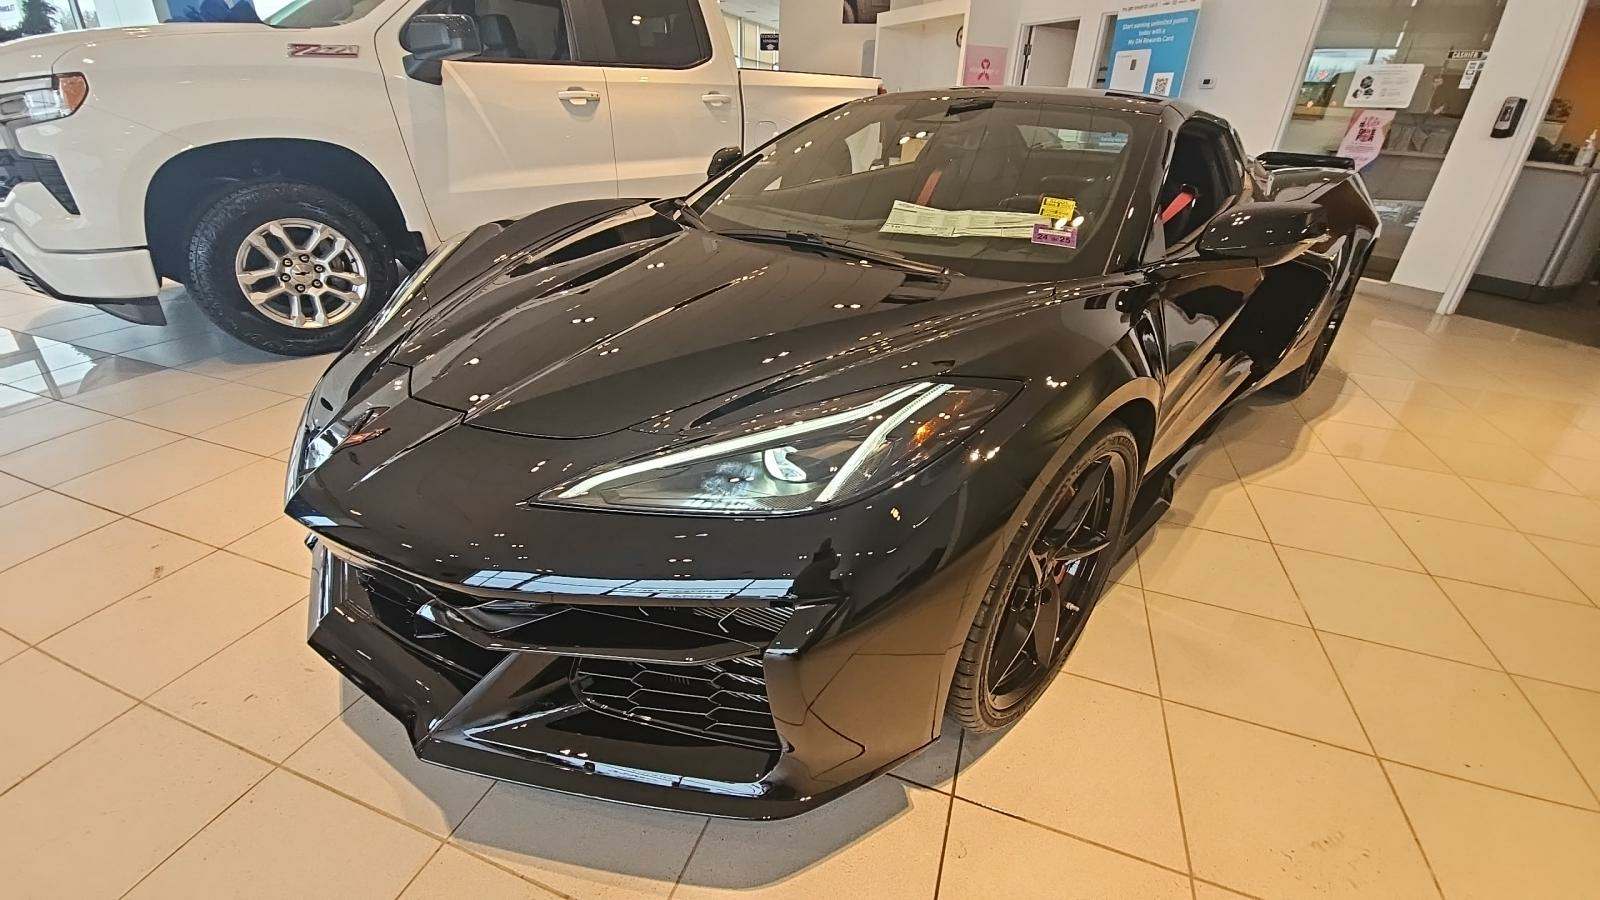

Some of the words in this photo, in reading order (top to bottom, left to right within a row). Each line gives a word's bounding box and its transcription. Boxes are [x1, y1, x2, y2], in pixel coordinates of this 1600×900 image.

[1151, 19, 1172, 27] unlimited
[1173, 17, 1189, 25] points
[1452, 51, 1479, 59] CASHIER
[1060, 235, 1071, 243] 25
